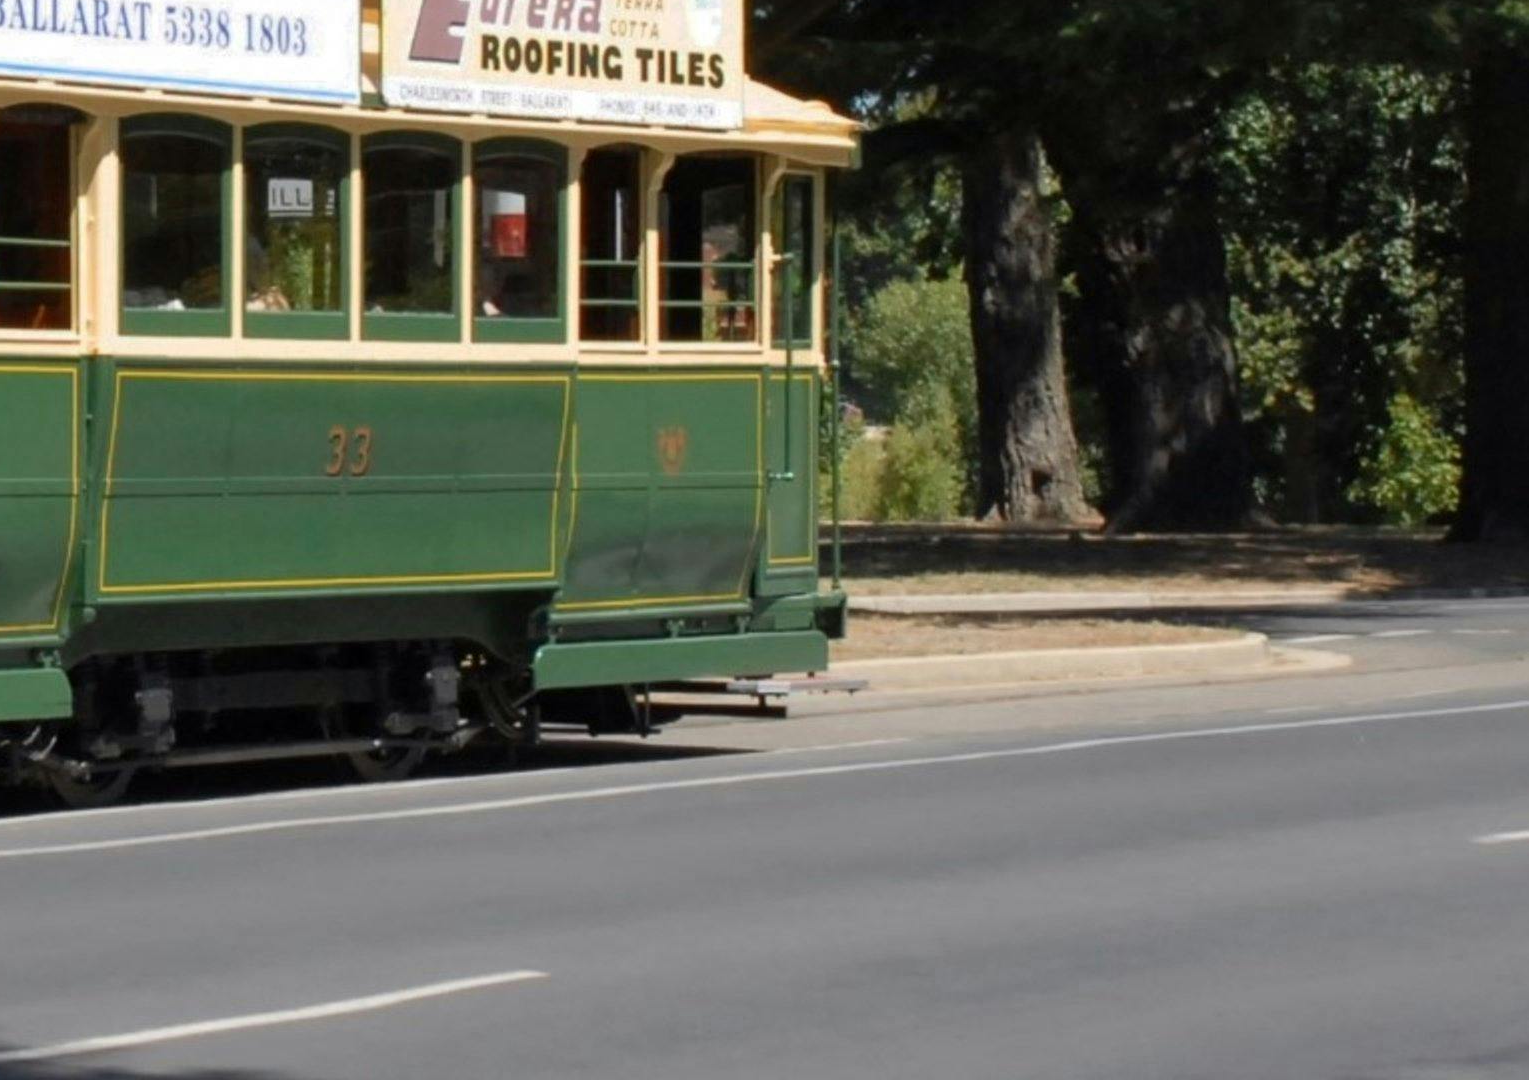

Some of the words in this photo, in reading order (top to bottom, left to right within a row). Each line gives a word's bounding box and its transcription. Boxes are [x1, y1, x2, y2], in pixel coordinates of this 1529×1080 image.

[163, 6, 231, 49] 5338
[243, 13, 307, 57] 1803
[610, 18, 659, 39] COTTA
[480, 33, 623, 81] ROOFING
[635, 48, 725, 90] TILES
[324, 423, 374, 478] 33
